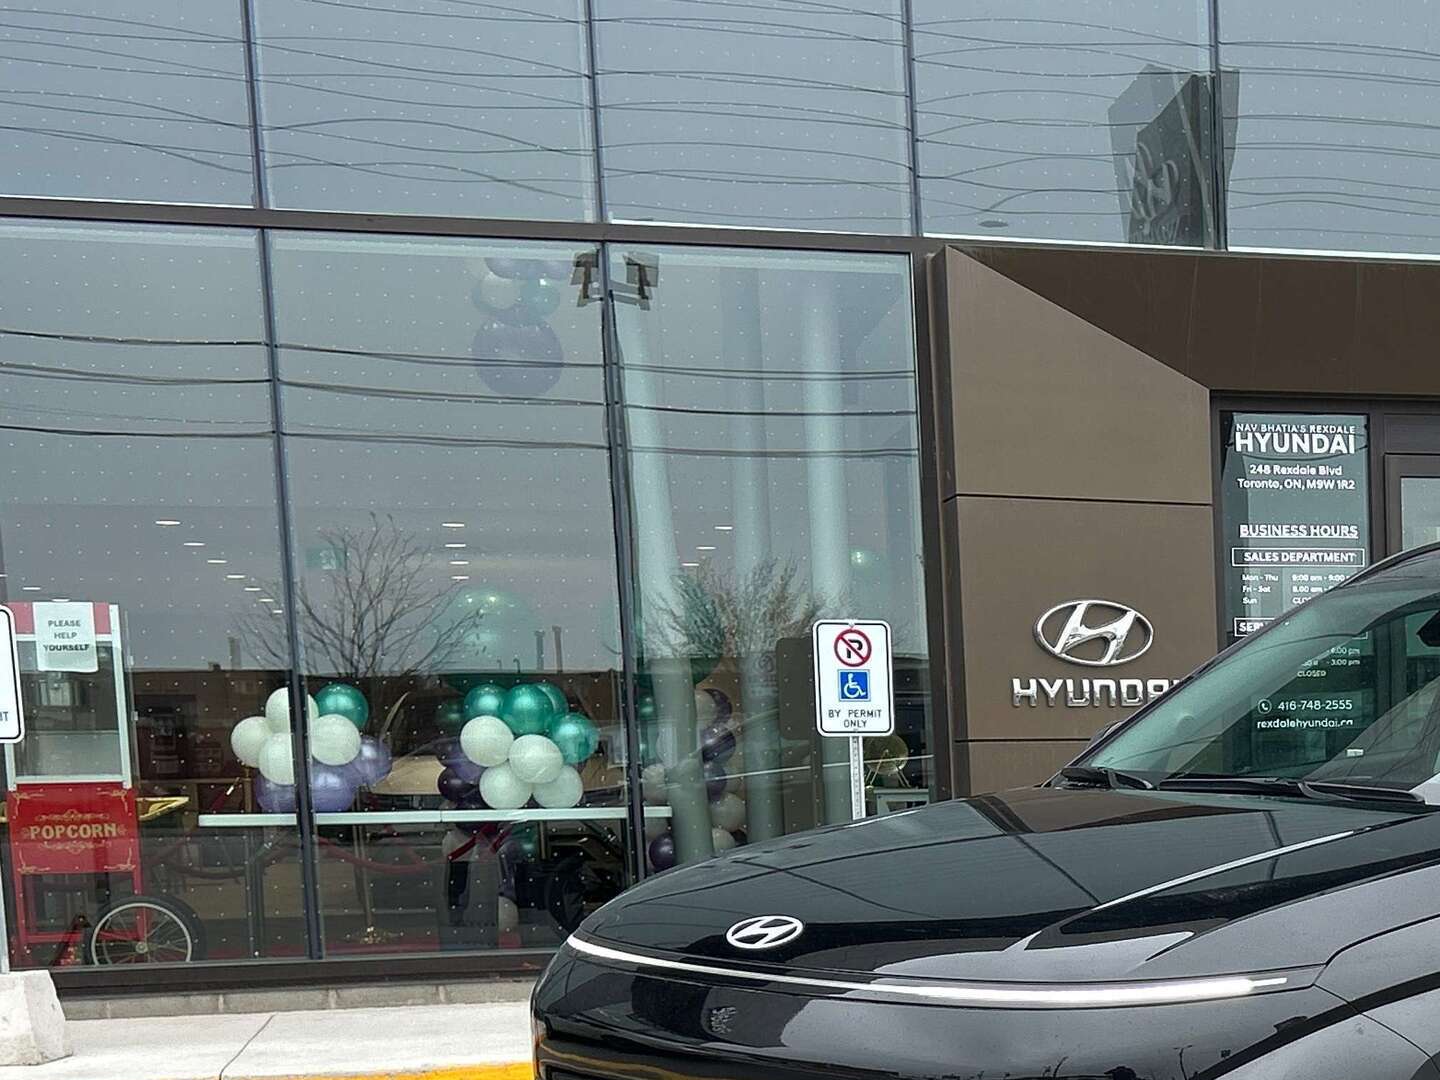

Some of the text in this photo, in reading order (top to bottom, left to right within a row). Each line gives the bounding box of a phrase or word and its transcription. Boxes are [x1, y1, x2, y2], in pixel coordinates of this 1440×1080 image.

[1236, 424, 1355, 433] NAV BHATIA'S REXDALE
[1235, 432, 1355, 454] HYUNDAI
[1249, 464, 1342, 476] 248 Rexdale Blvd
[1237, 478, 1355, 490] Toronto, ON, M9W 1R2
[1240, 524, 1358, 538] BUSINESS HOURS
[1244, 552, 1356, 562] SALES DEPARTMENT
[48, 619, 81, 628] PLEASE
[54, 631, 77, 640] HELP
[43, 643, 90, 652] YOURSELF
[1013, 677, 1182, 708] HYUNDA
[1278, 699, 1353, 711] 416-748-2555
[829, 709, 882, 718] BY PERMIT
[844, 719, 867, 728] ONLY
[30, 823, 117, 840] POPCORN
